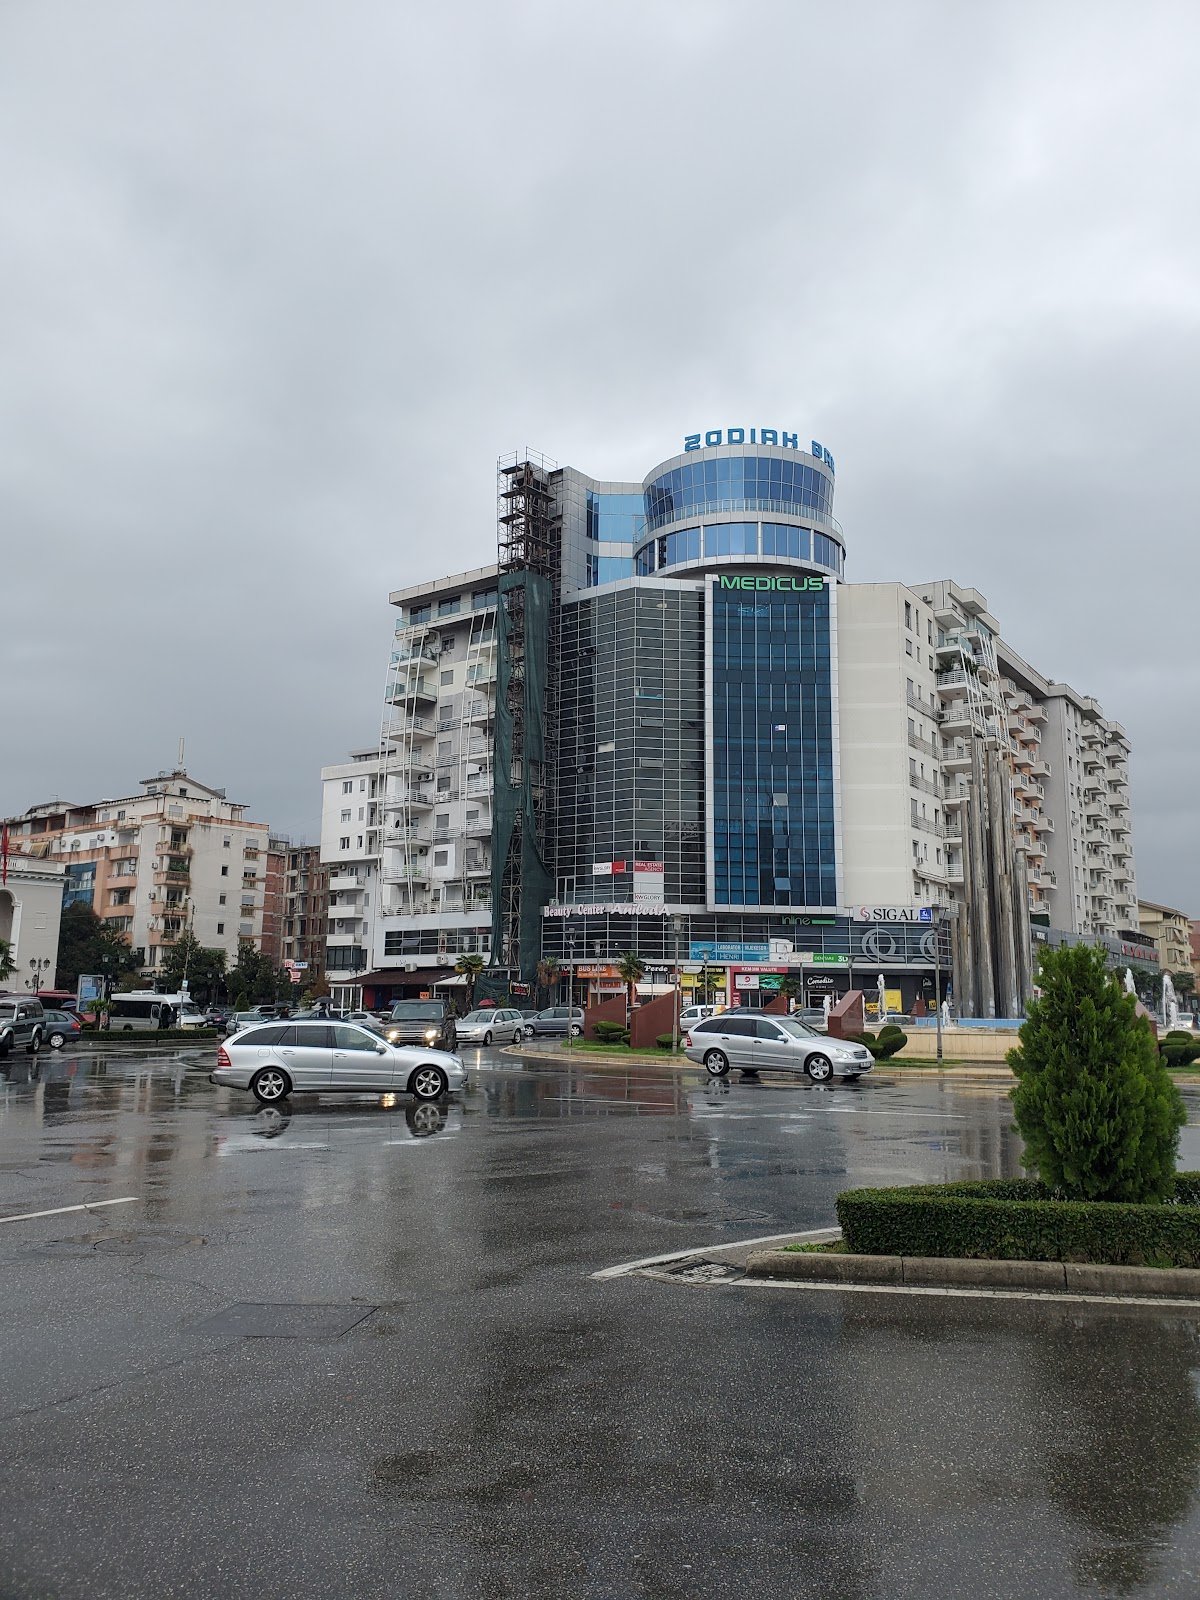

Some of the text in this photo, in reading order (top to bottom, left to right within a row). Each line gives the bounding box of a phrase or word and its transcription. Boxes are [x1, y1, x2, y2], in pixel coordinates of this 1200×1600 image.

[684, 427, 799, 452] ZODIAK
[720, 575, 824, 591] MEDICUS
[543, 905, 572, 918] Beauty
[577, 903, 605, 915] Center
[873, 908, 919, 921] SIGAL
[592, 964, 607, 972] LINE
[644, 964, 668, 972] Perde
